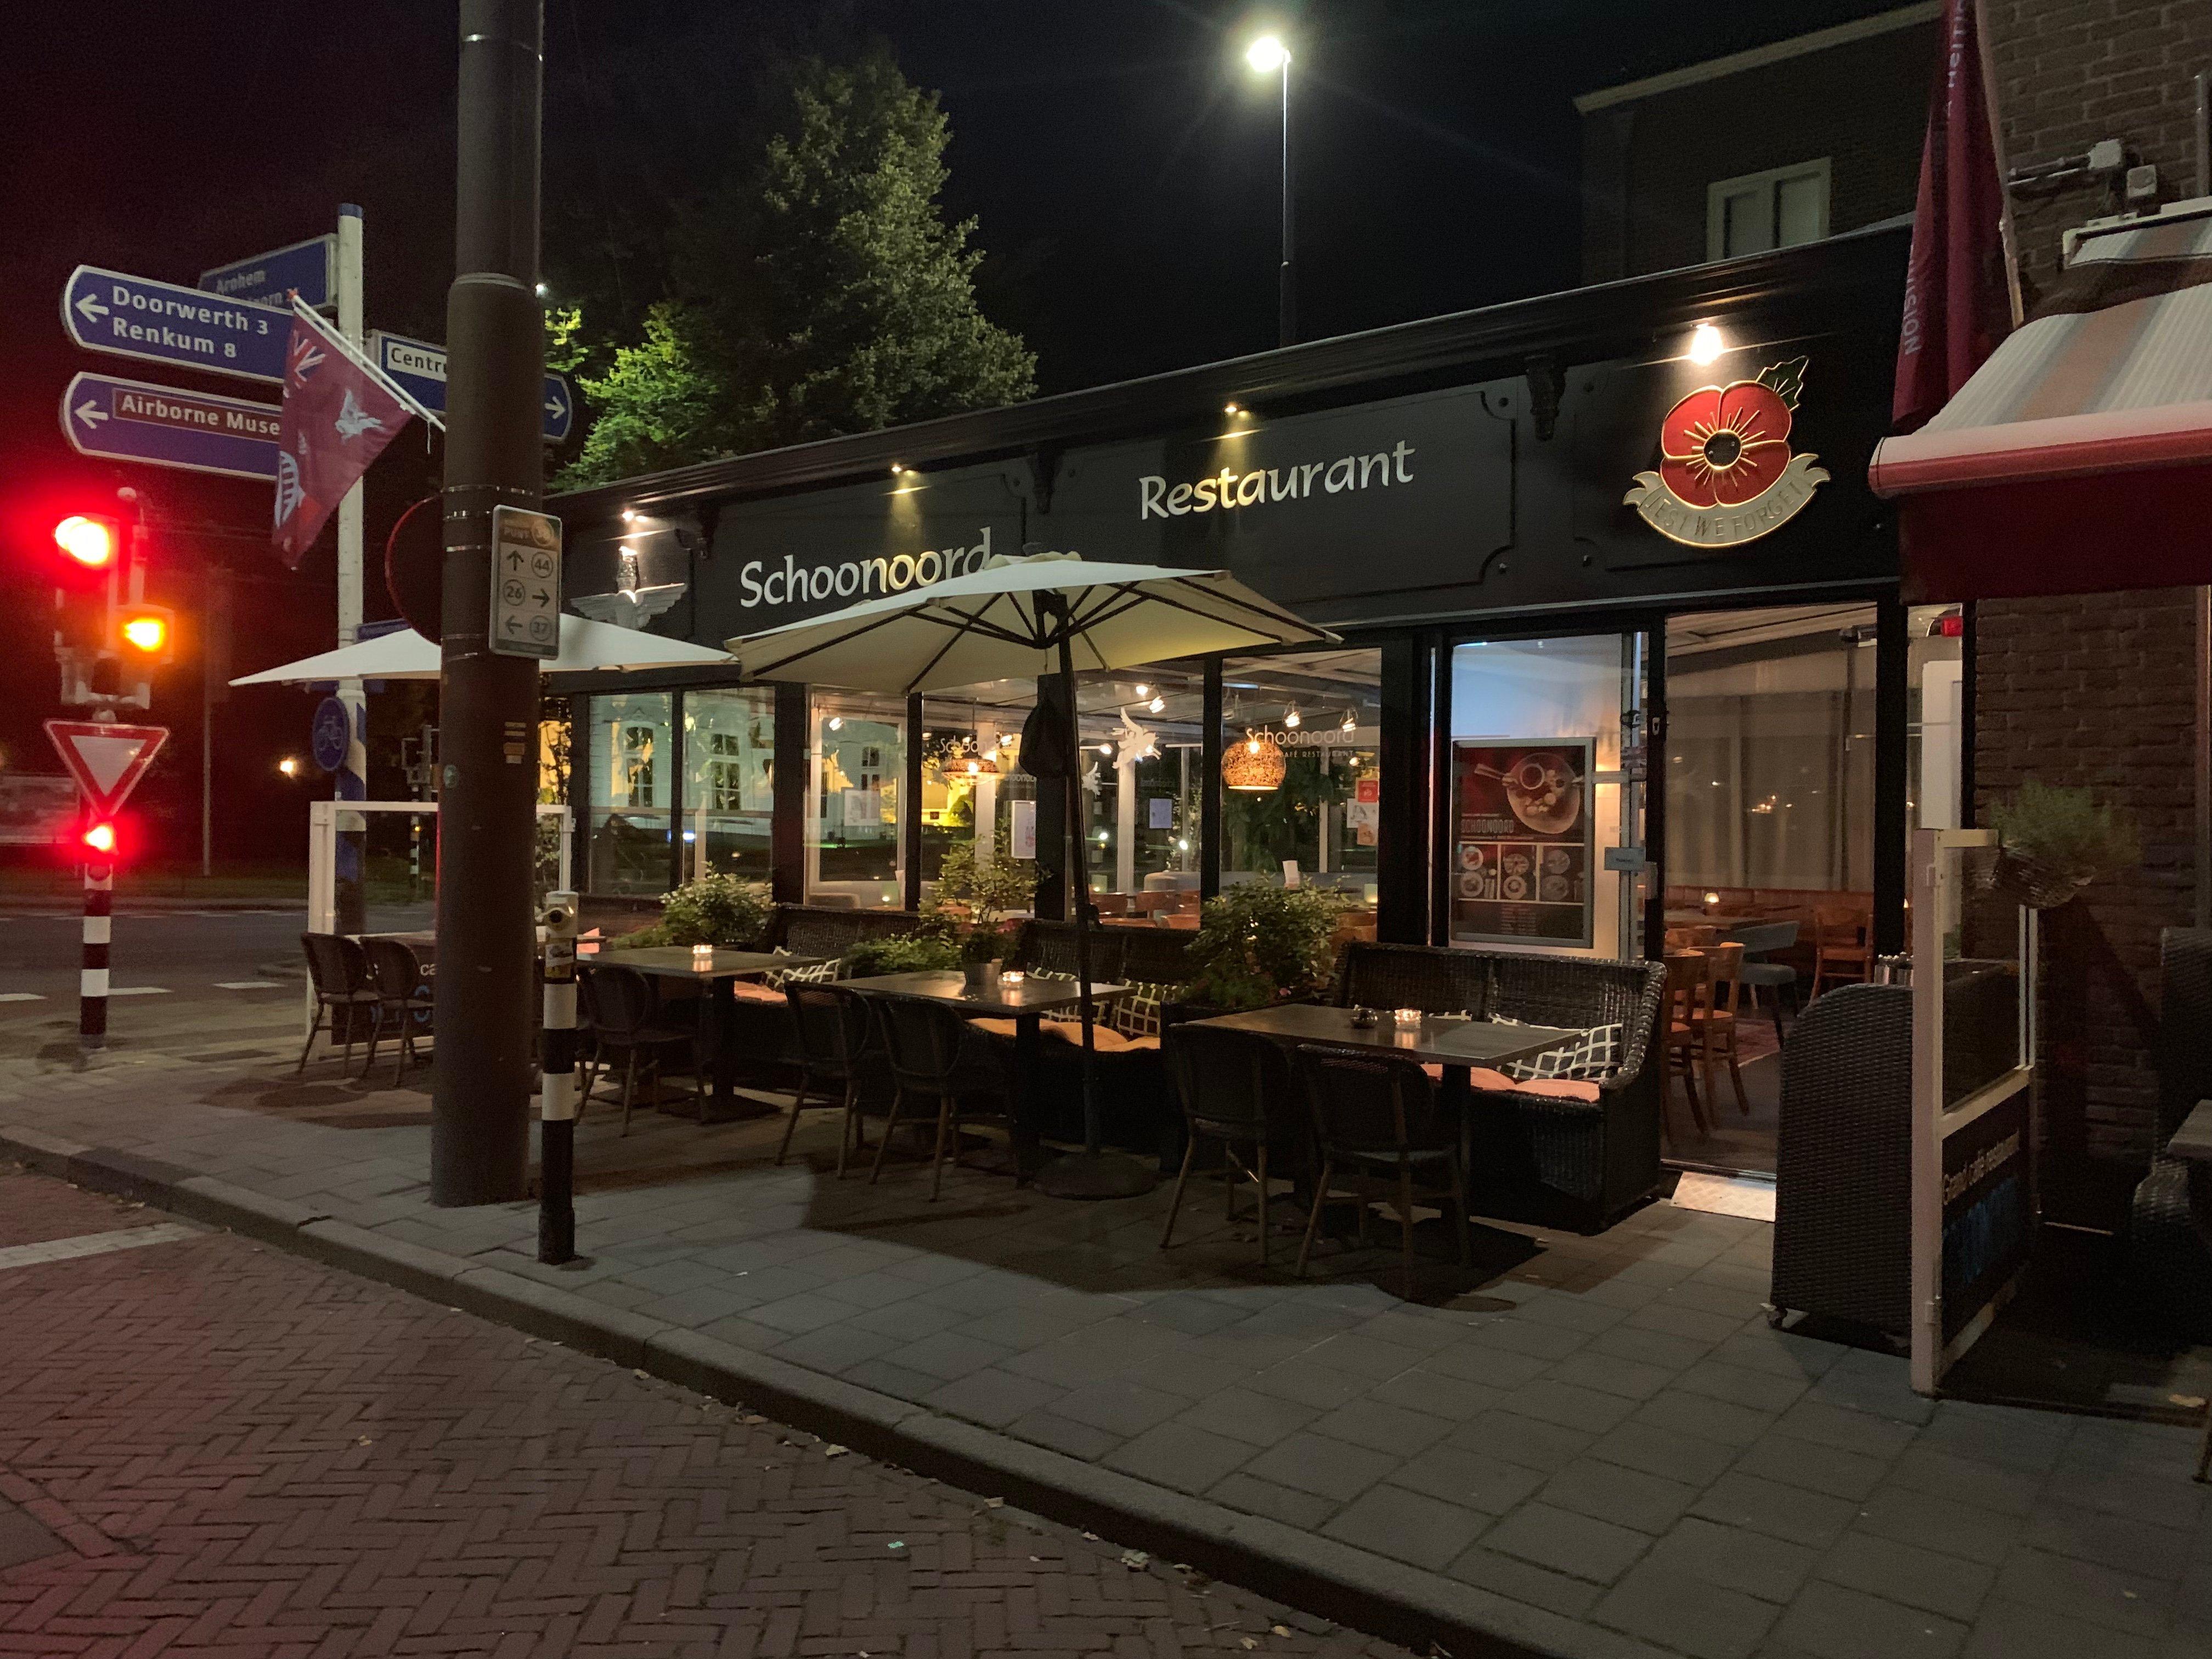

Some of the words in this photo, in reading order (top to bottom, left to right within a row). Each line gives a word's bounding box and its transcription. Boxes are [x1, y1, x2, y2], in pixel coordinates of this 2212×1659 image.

[113, 286, 247, 331] Doorwerth
[256, 320, 268, 335] 3
[113, 317, 215, 354] Renkum
[224, 343, 237, 358] 8
[391, 347, 447, 374] Centr
[121, 394, 219, 426] Airborne
[227, 413, 280, 435] Muse
[1138, 440, 1415, 520] Restaurant
[1695, 515, 1726, 537] WE
[1731, 478, 1805, 535] FORGET
[534, 558, 549, 571] 44
[740, 526, 991, 608] Schoonoord
[506, 585, 522, 599] 26
[1246, 724, 1354, 745] Schoonoord
